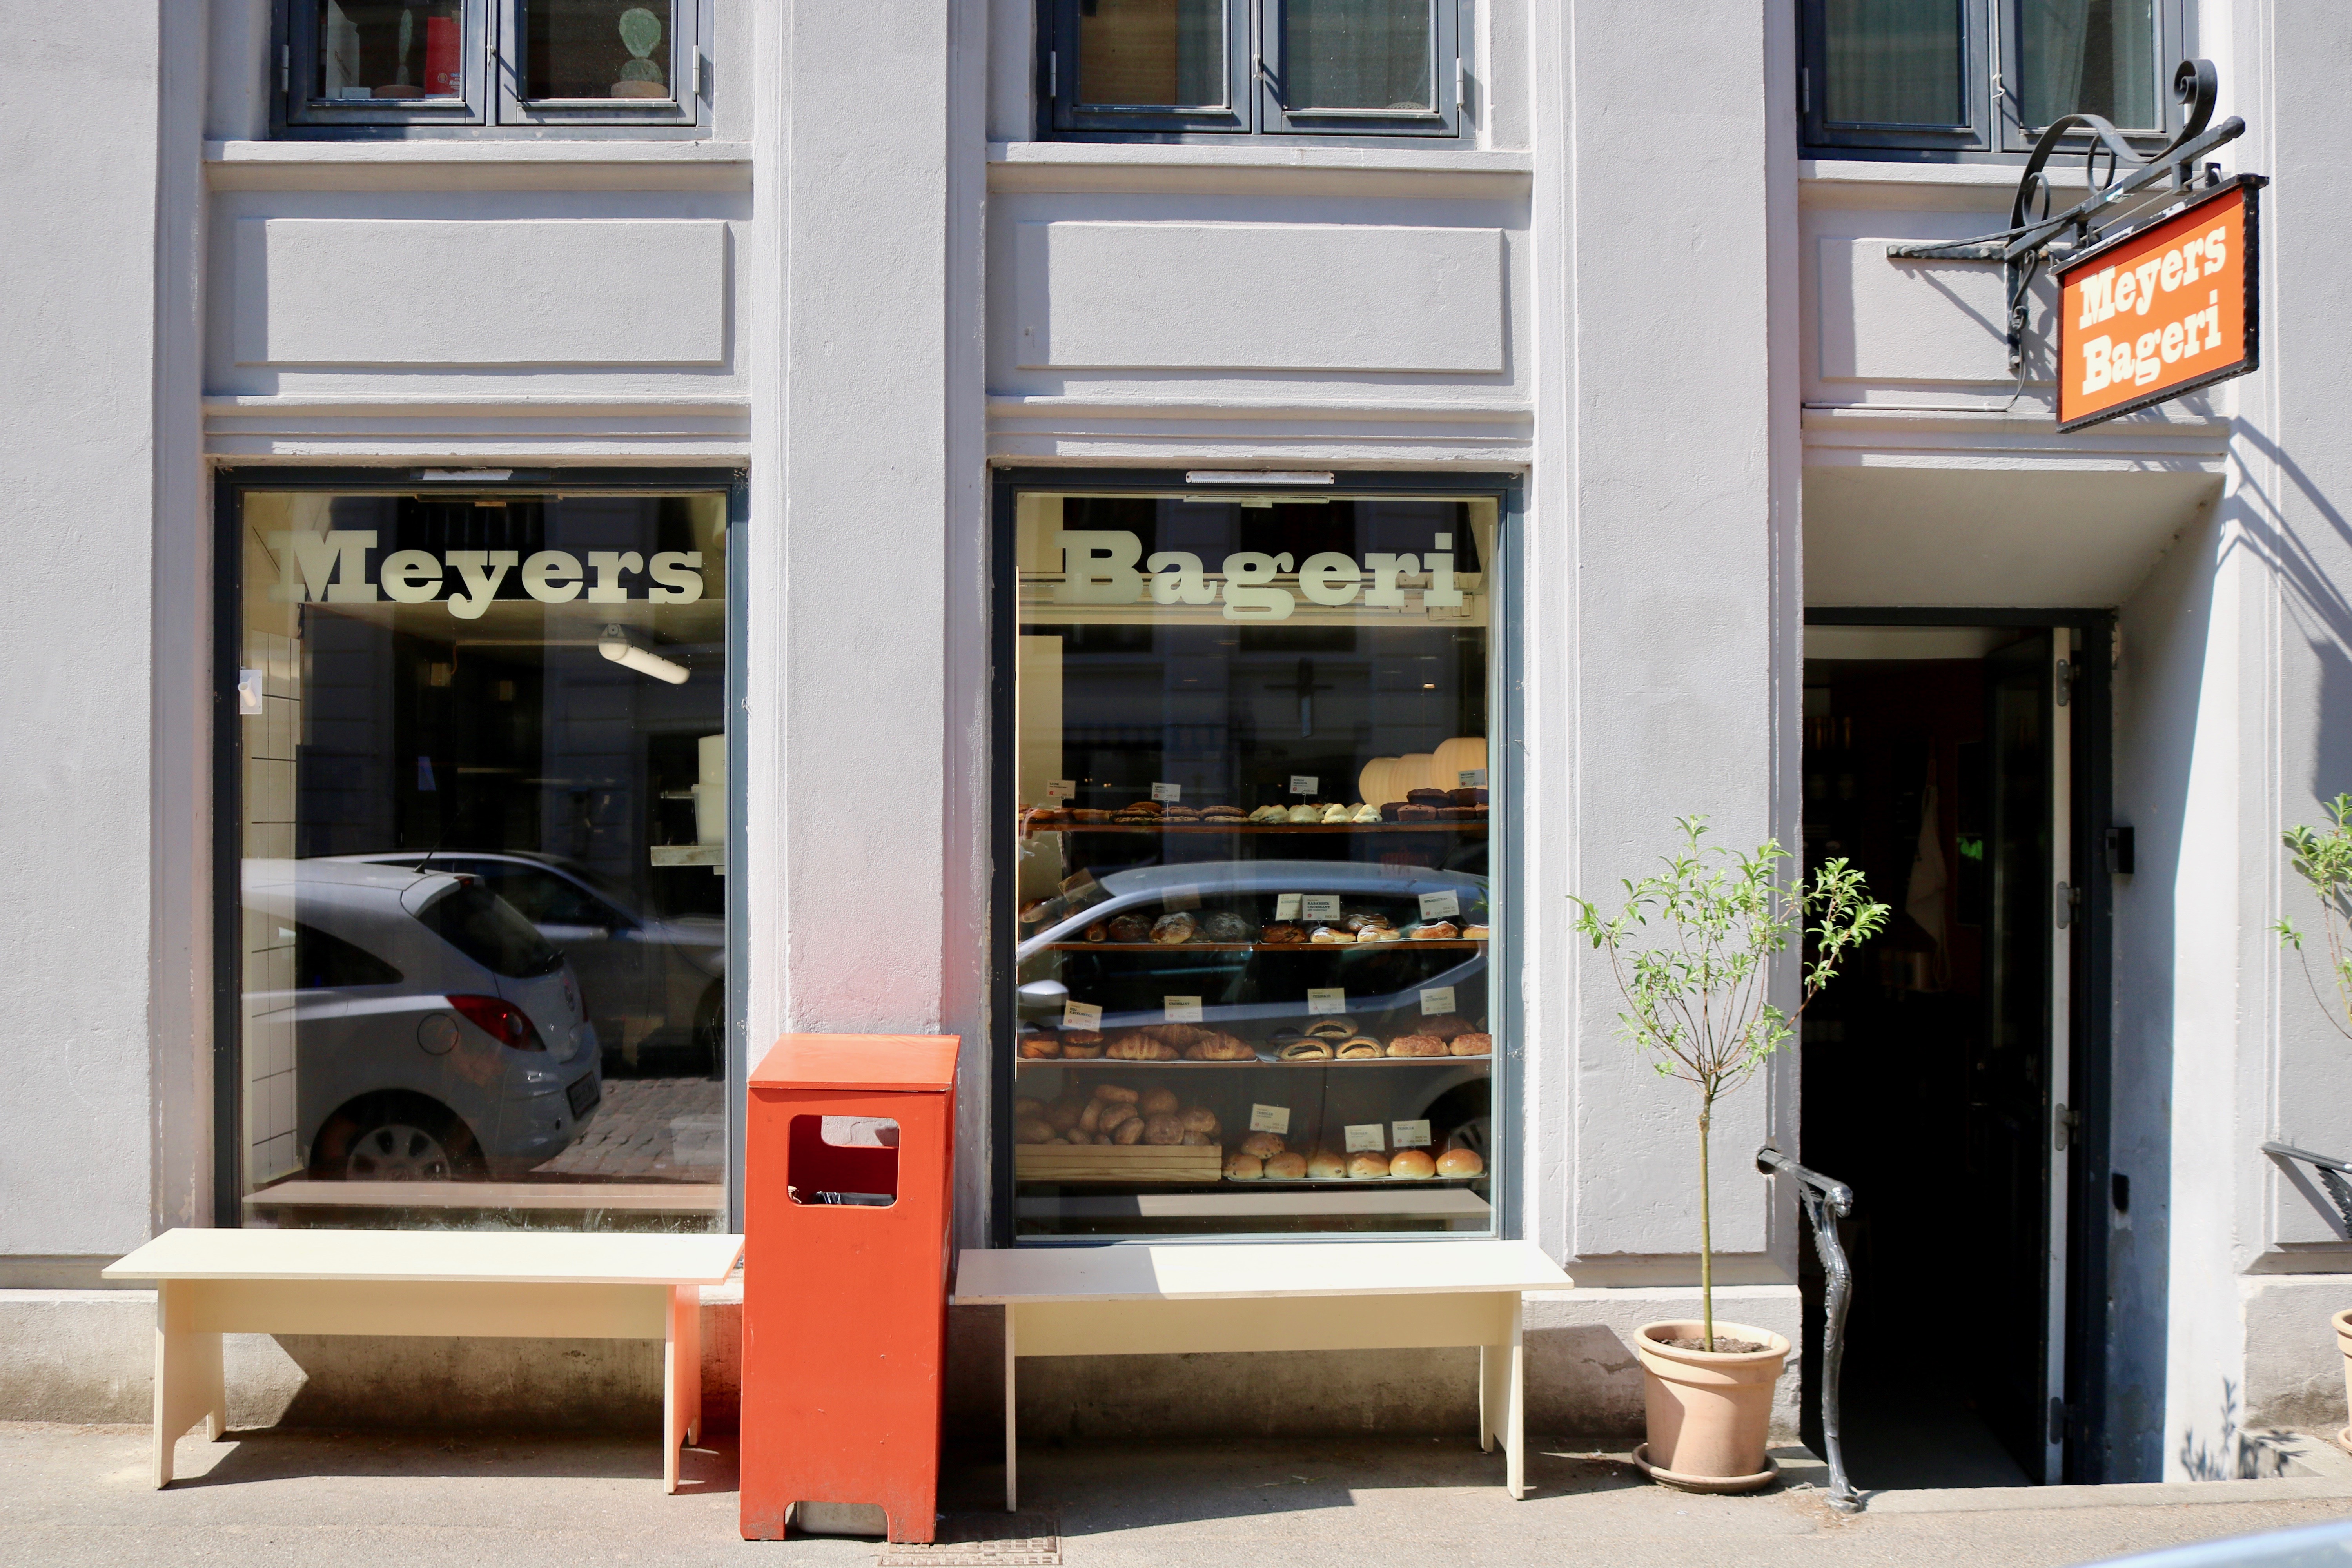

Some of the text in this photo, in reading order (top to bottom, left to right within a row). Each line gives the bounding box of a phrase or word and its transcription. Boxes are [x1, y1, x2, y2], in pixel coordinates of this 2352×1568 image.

[2079, 226, 2226, 330] Meyers
[2082, 289, 2221, 395] Bageri
[268, 530, 703, 619] Meyers
[1053, 530, 1463, 620] Bageri
